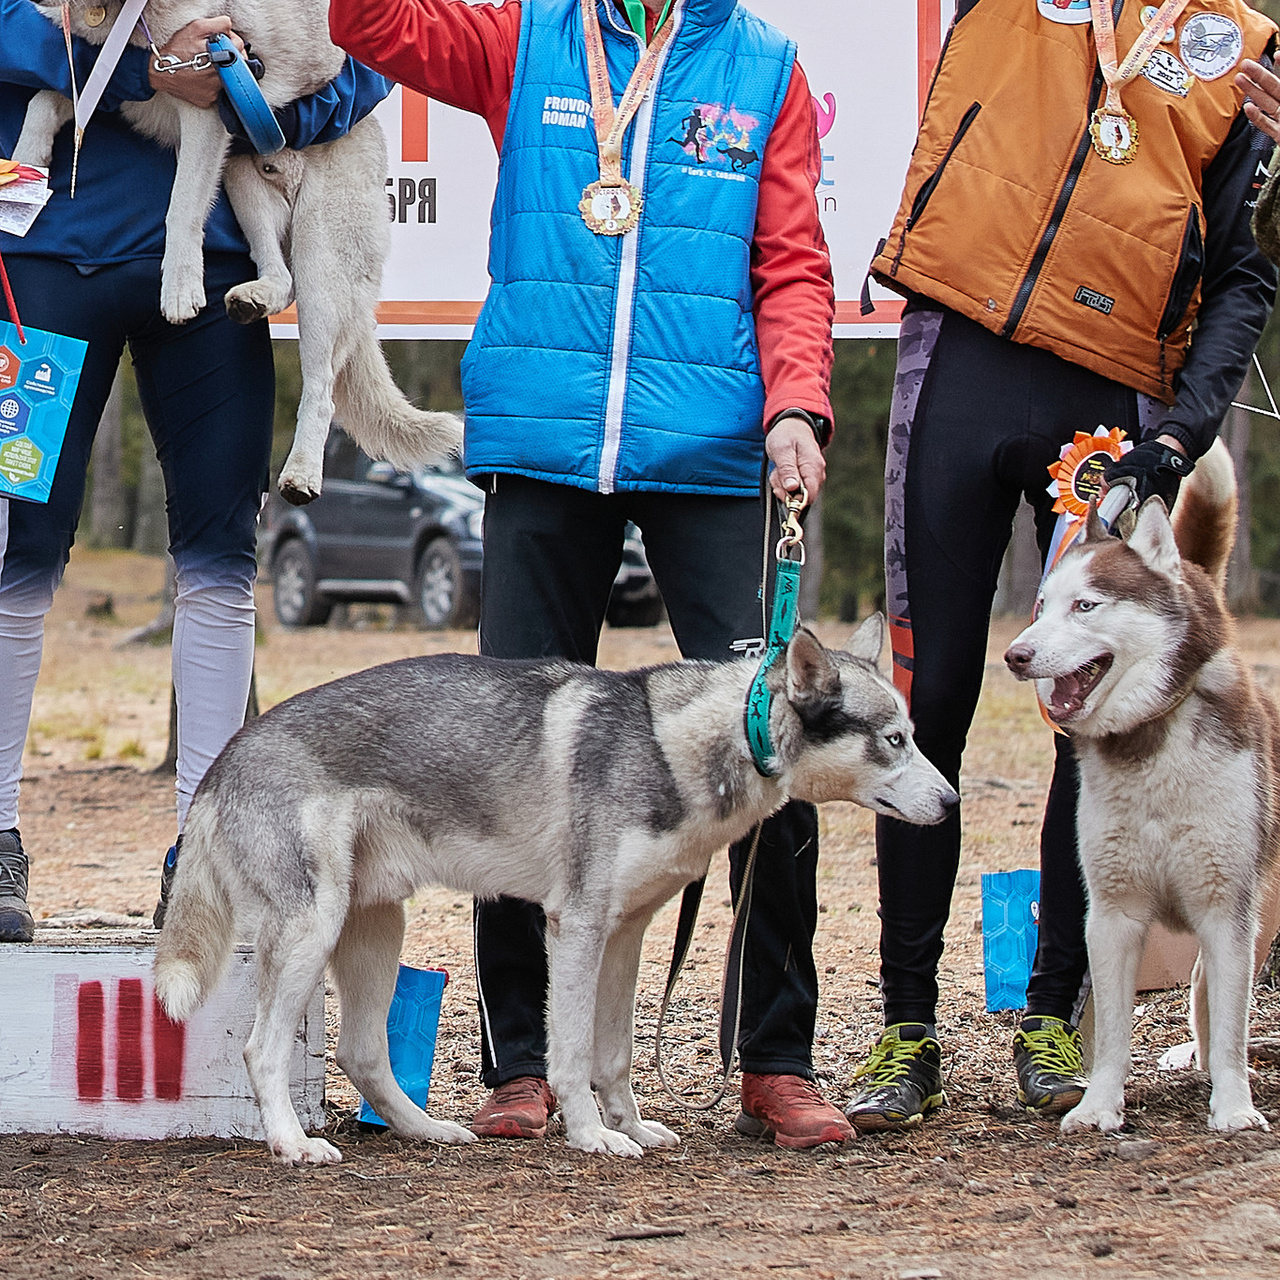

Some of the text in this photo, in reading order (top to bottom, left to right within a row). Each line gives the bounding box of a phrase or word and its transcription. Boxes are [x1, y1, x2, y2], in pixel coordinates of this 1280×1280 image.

[544, 96, 594, 113] PROVOT
[542, 111, 587, 128] ROMAN
[608, 221, 614, 229] 3
